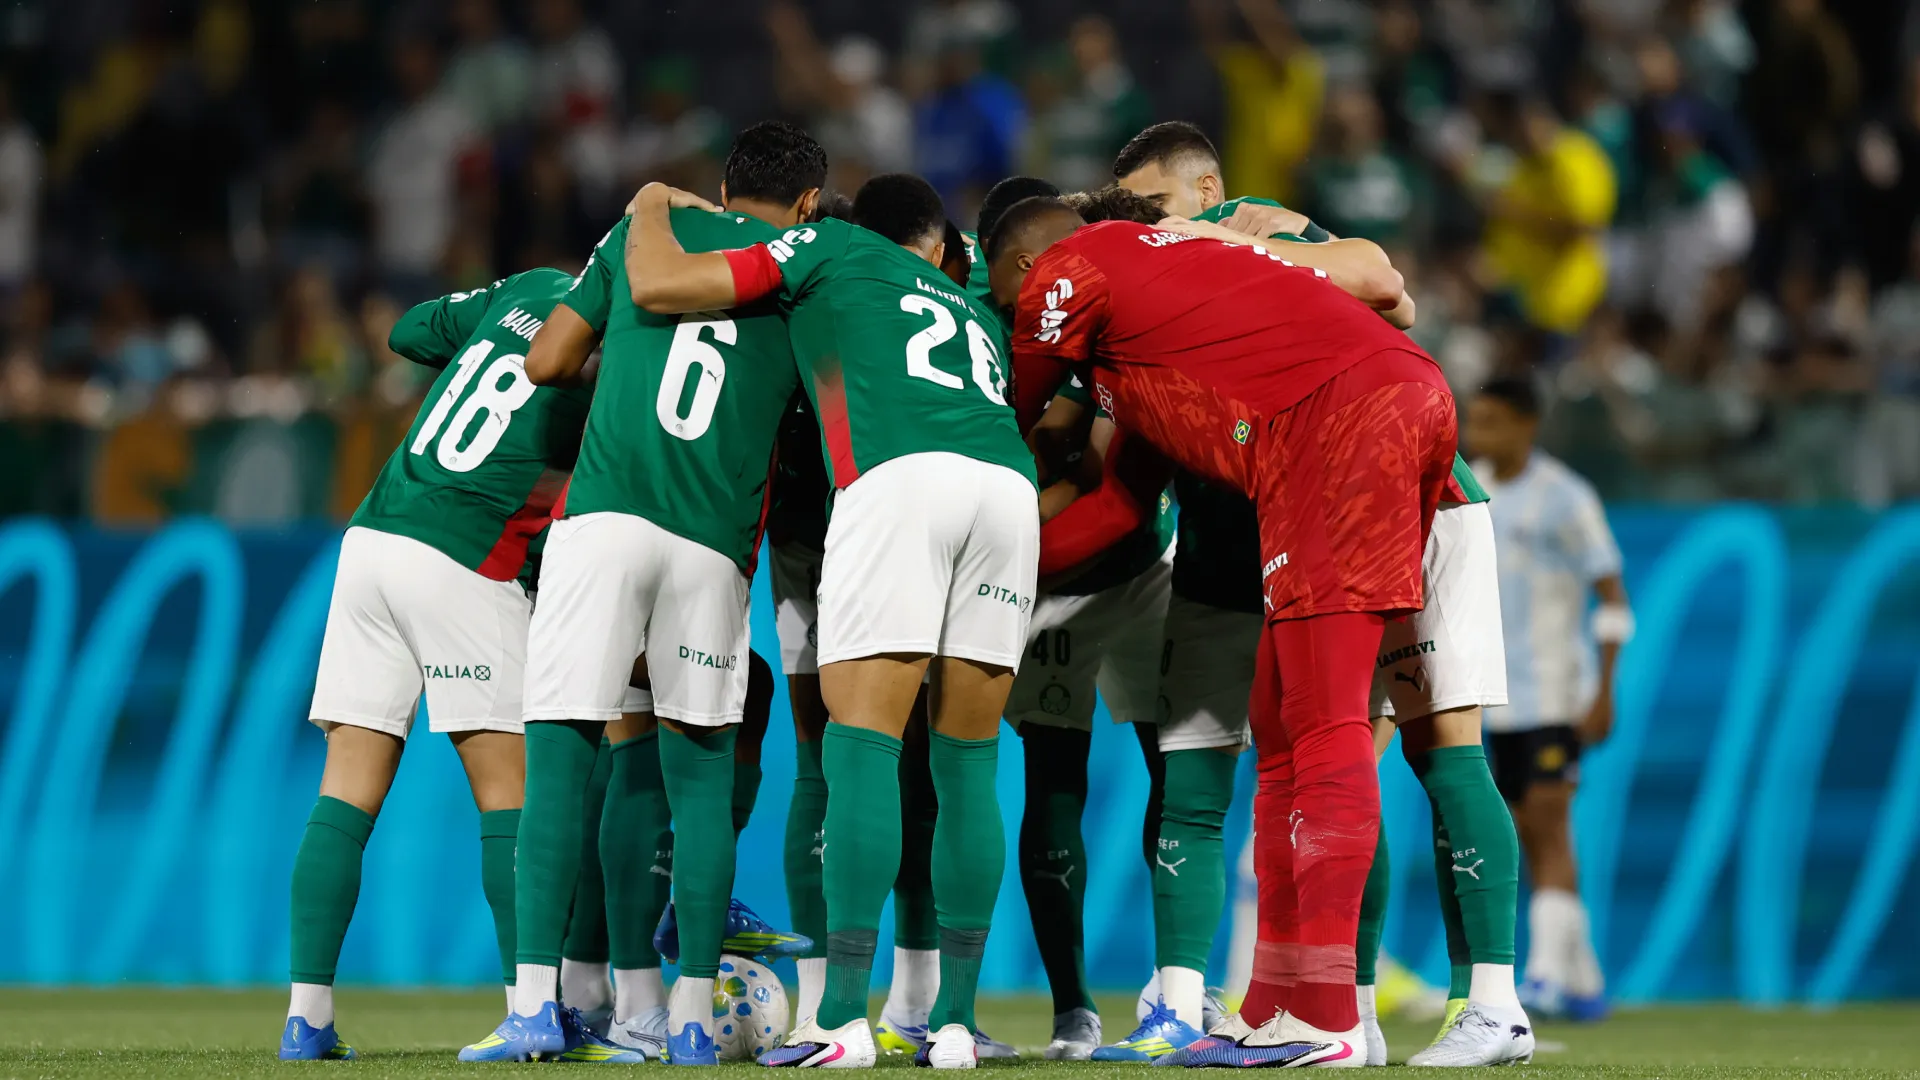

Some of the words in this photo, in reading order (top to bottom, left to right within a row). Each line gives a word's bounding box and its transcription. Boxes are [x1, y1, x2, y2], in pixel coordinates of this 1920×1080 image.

[410, 339, 537, 472] 18
[656, 311, 737, 441] 6
[1031, 629, 1071, 667] 40
